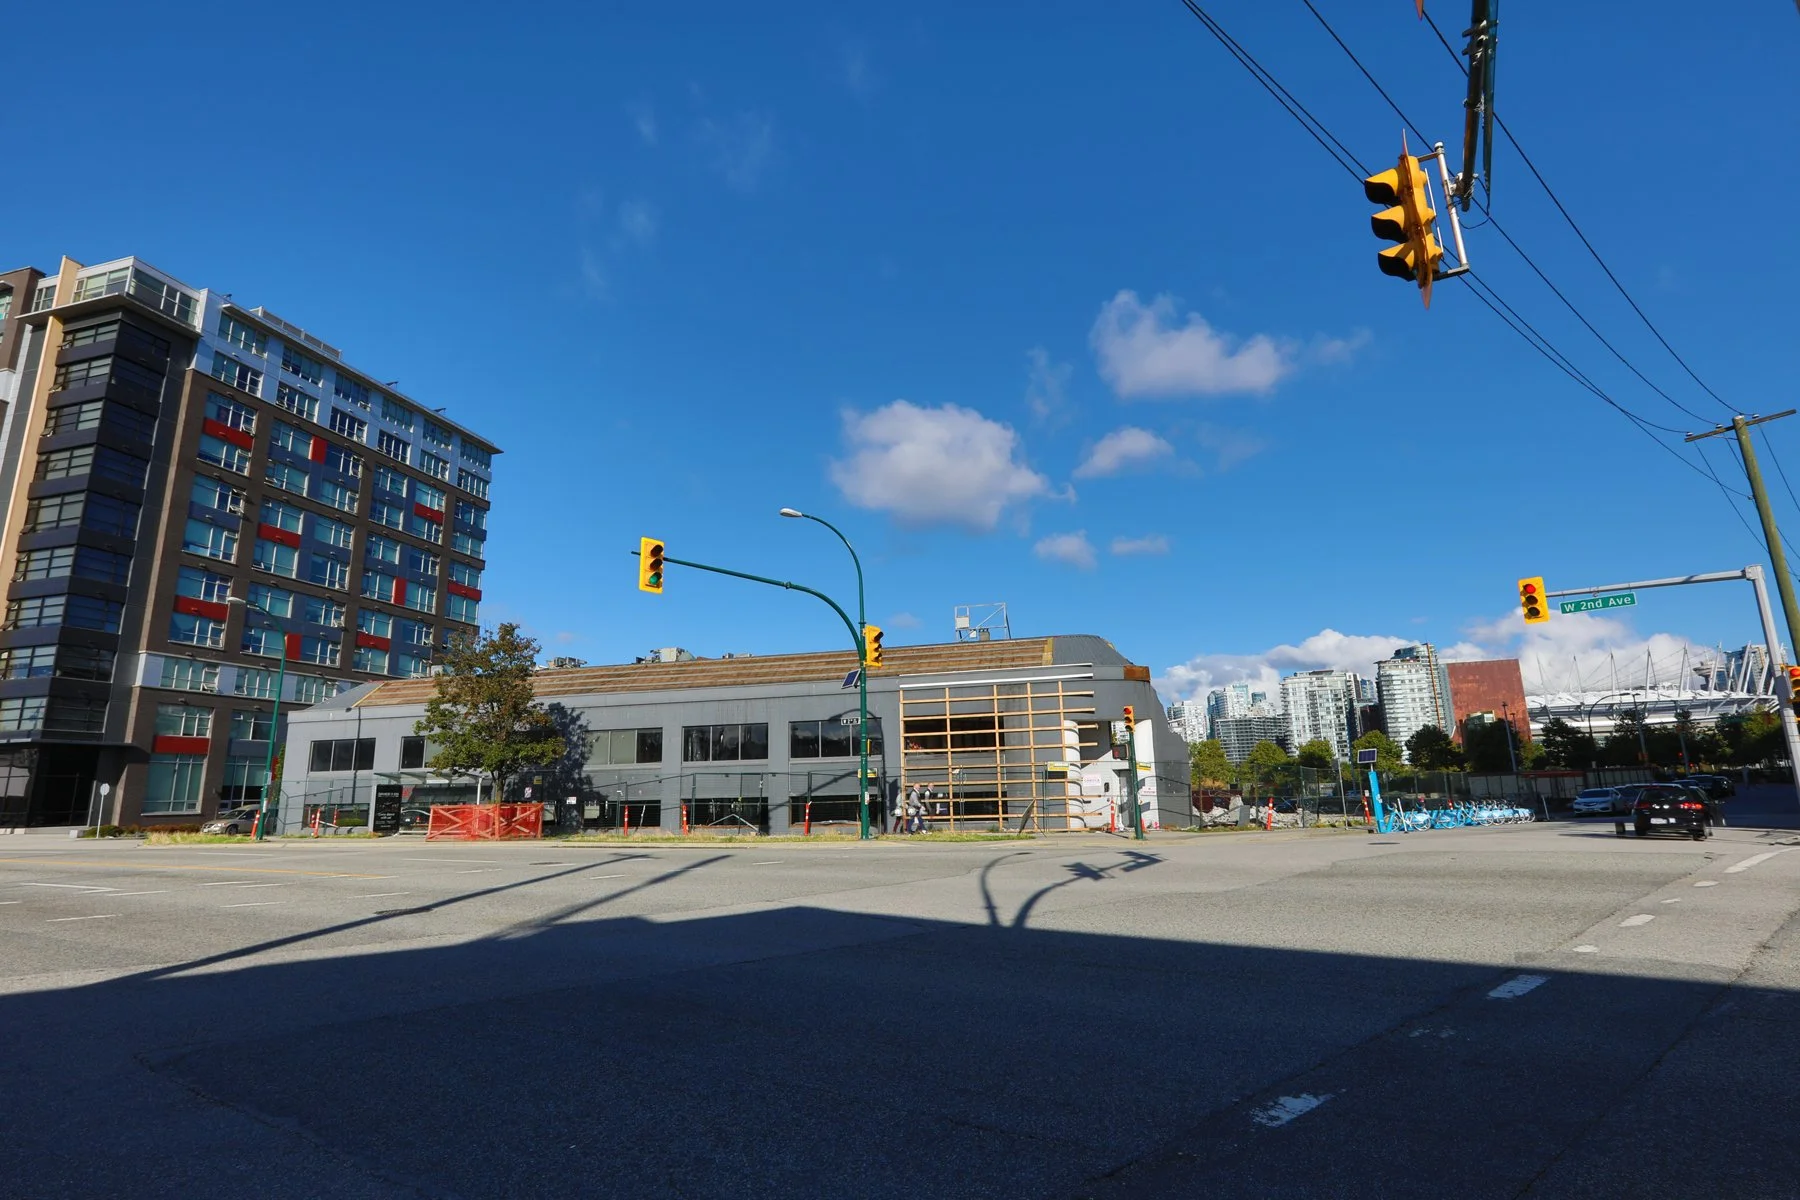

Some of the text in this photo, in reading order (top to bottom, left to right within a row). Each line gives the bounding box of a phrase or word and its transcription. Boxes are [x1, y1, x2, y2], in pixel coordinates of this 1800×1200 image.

[1564, 597, 1631, 612] W 2nd Ave
